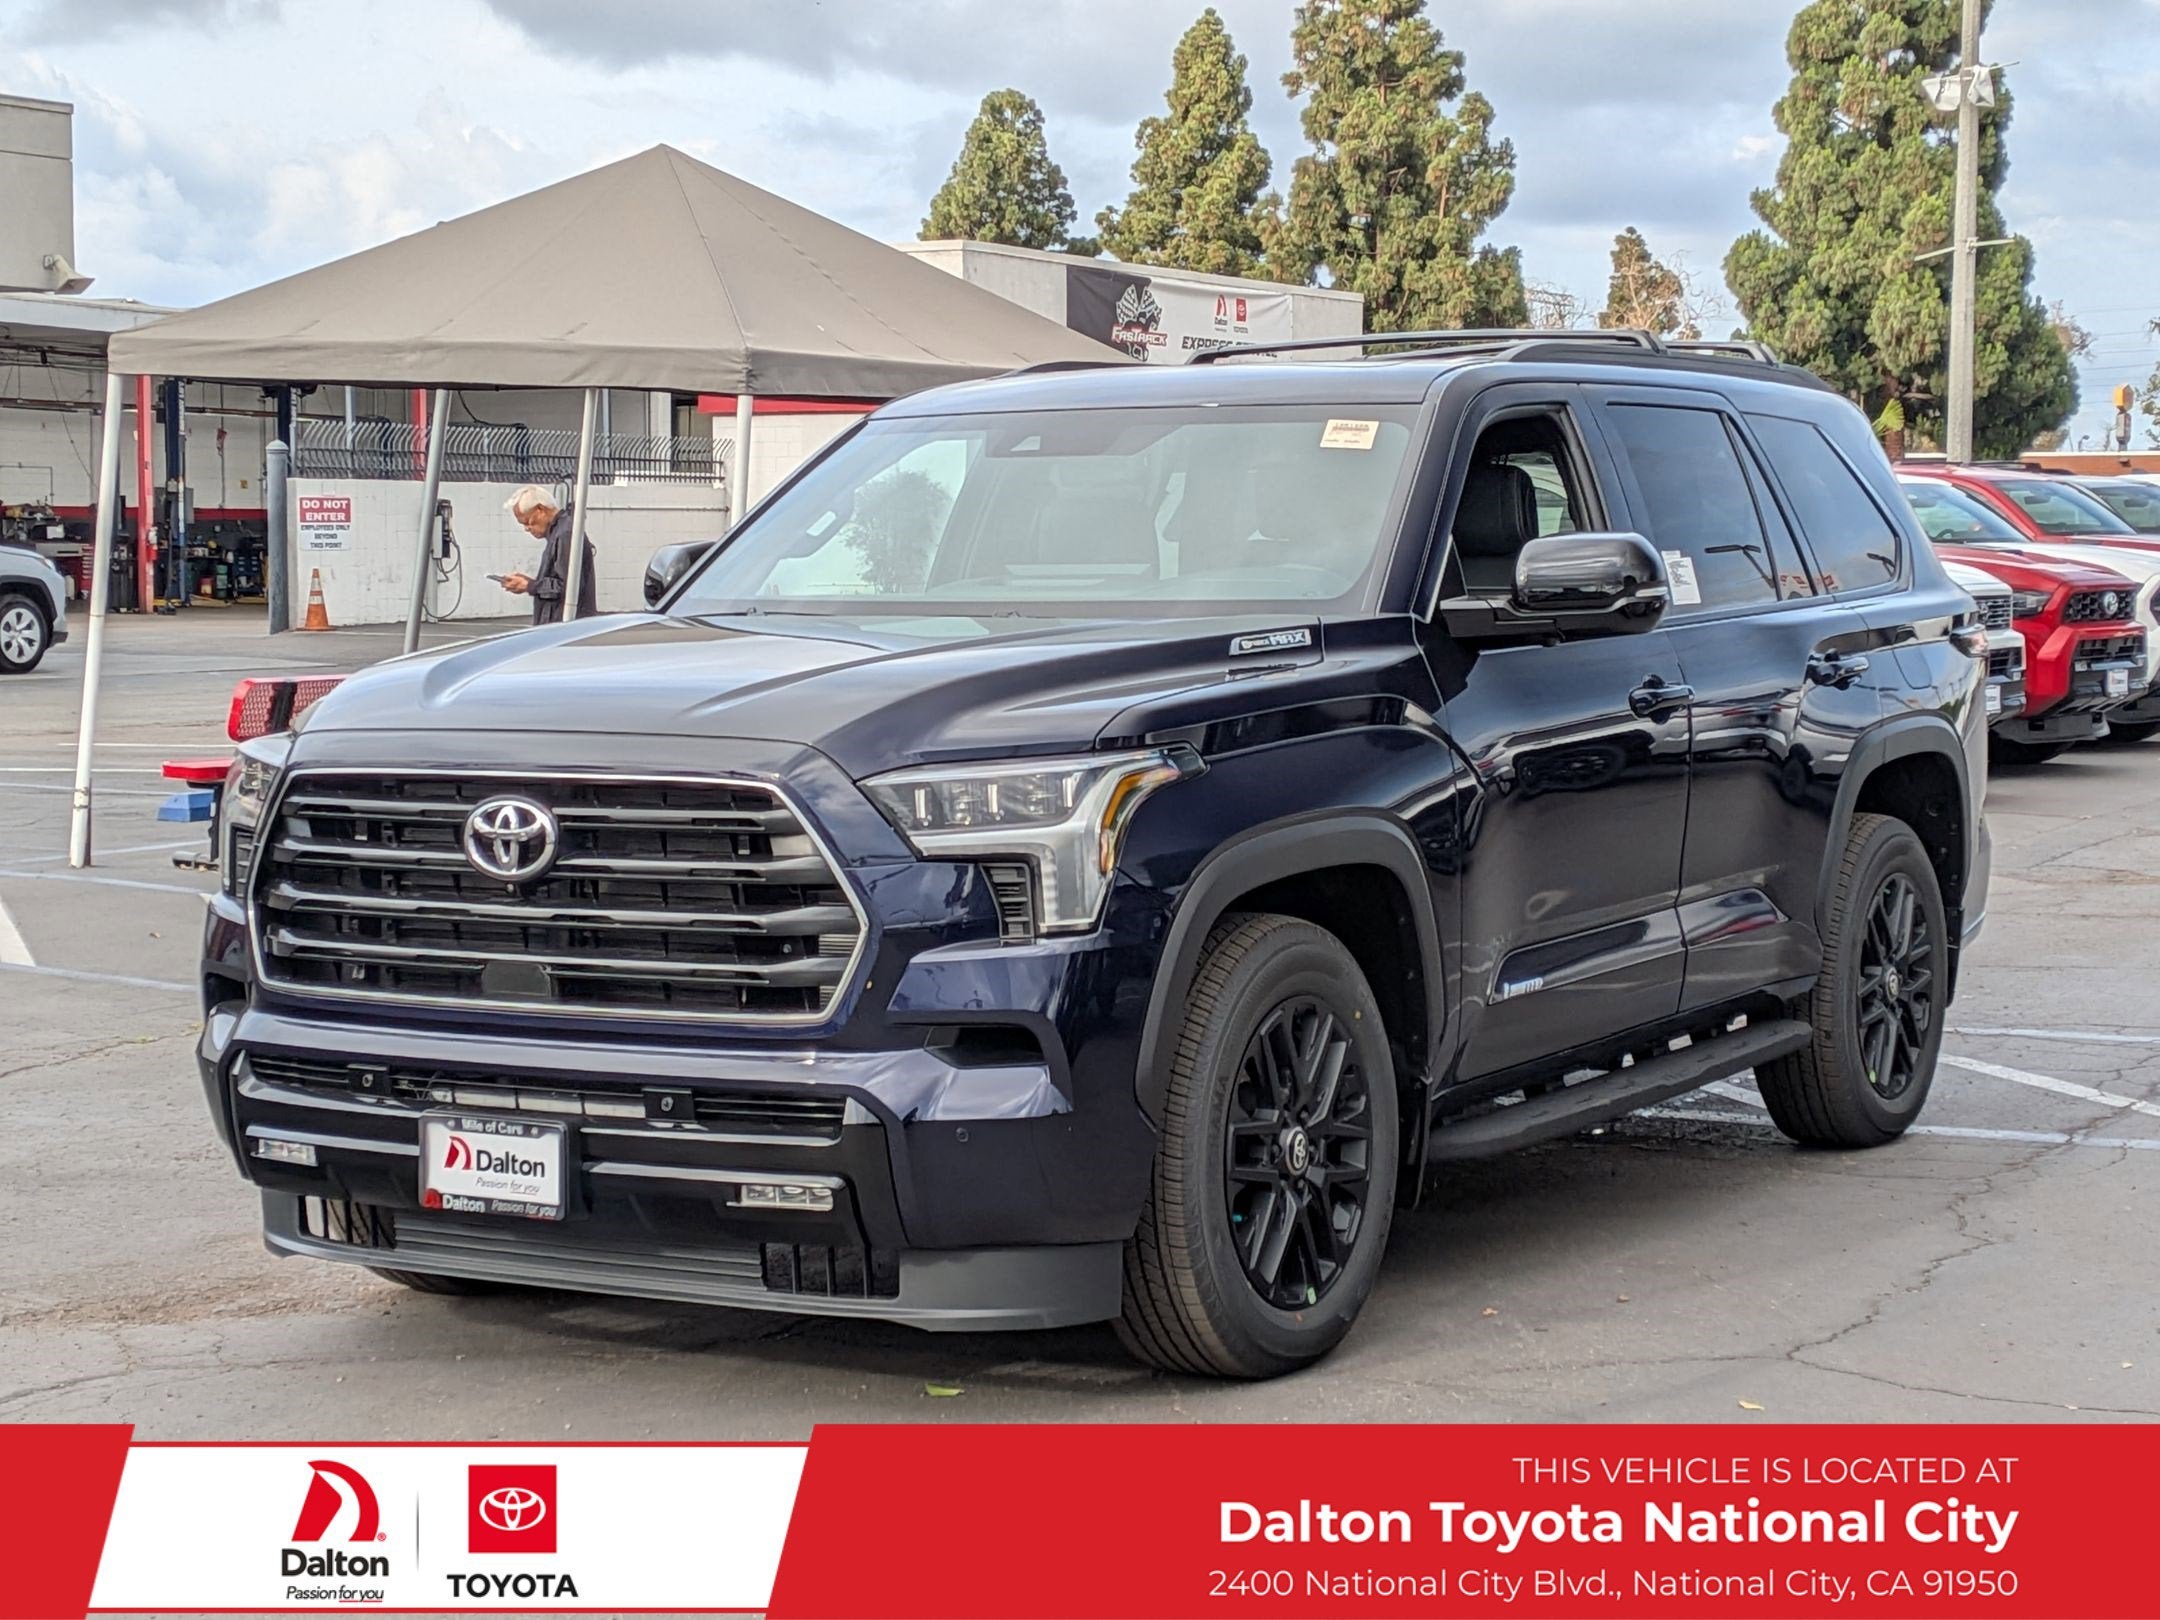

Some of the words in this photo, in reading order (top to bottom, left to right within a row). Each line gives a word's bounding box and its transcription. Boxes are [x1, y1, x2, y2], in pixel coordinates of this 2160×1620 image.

[302, 500, 320, 509] DO
[323, 500, 348, 509] NOT
[305, 512, 346, 521] ENTER
[461, 1118, 483, 1131] Mile
[485, 1121, 496, 1133] of
[498, 1122, 524, 1136] Cars
[476, 1149, 545, 1178] Dalton
[475, 1176, 508, 1191] Passion
[509, 1180, 523, 1193] for
[523, 1183, 541, 1195] you
[442, 1194, 486, 1214] Dalton
[491, 1199, 524, 1214] Passion
[525, 1202, 538, 1217] for
[537, 1205, 557, 1219] you
